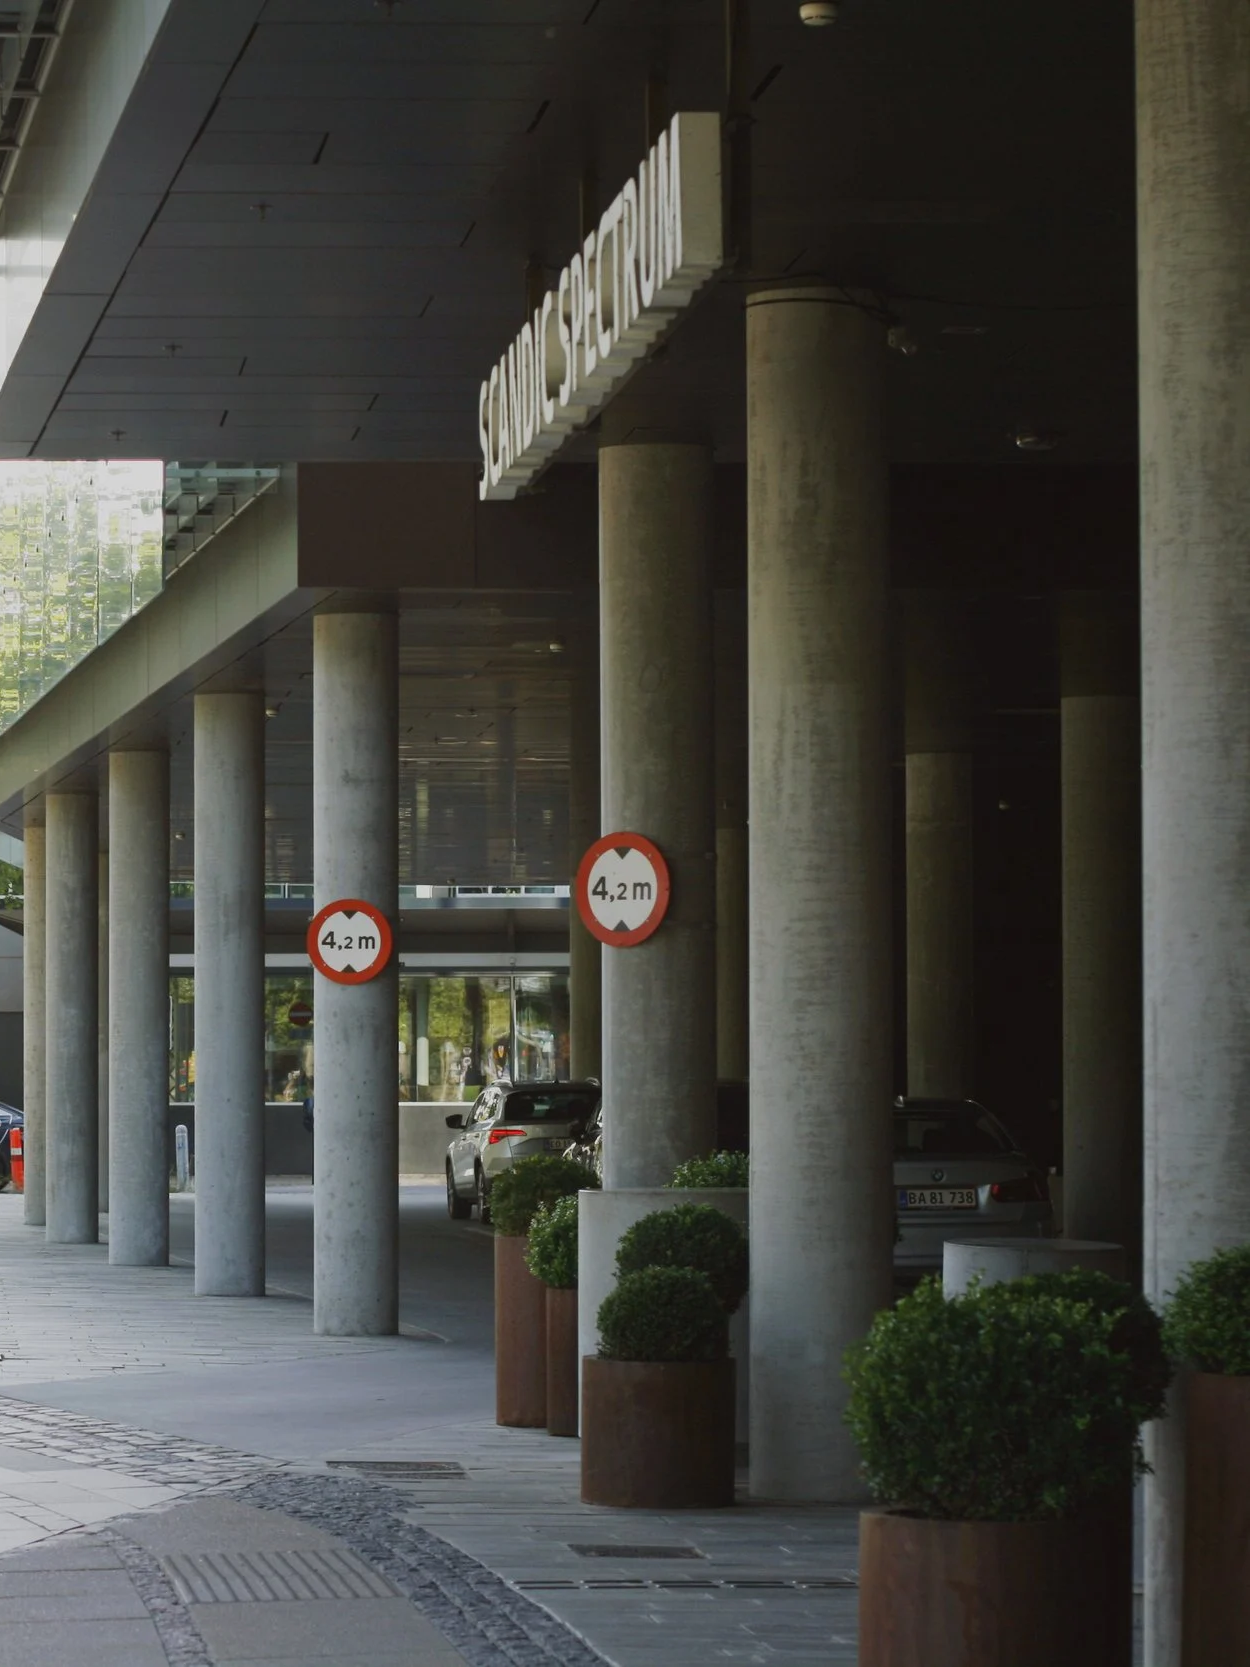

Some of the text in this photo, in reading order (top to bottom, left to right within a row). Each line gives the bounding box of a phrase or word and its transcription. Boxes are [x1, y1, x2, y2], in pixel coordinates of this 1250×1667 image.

[479, 112, 682, 500] SCANDIC SPECTRUM
[591, 876, 652, 902] 4,2 m
[321, 931, 376, 950] 4,2 m
[908, 1191, 975, 1205] BA 81 738
